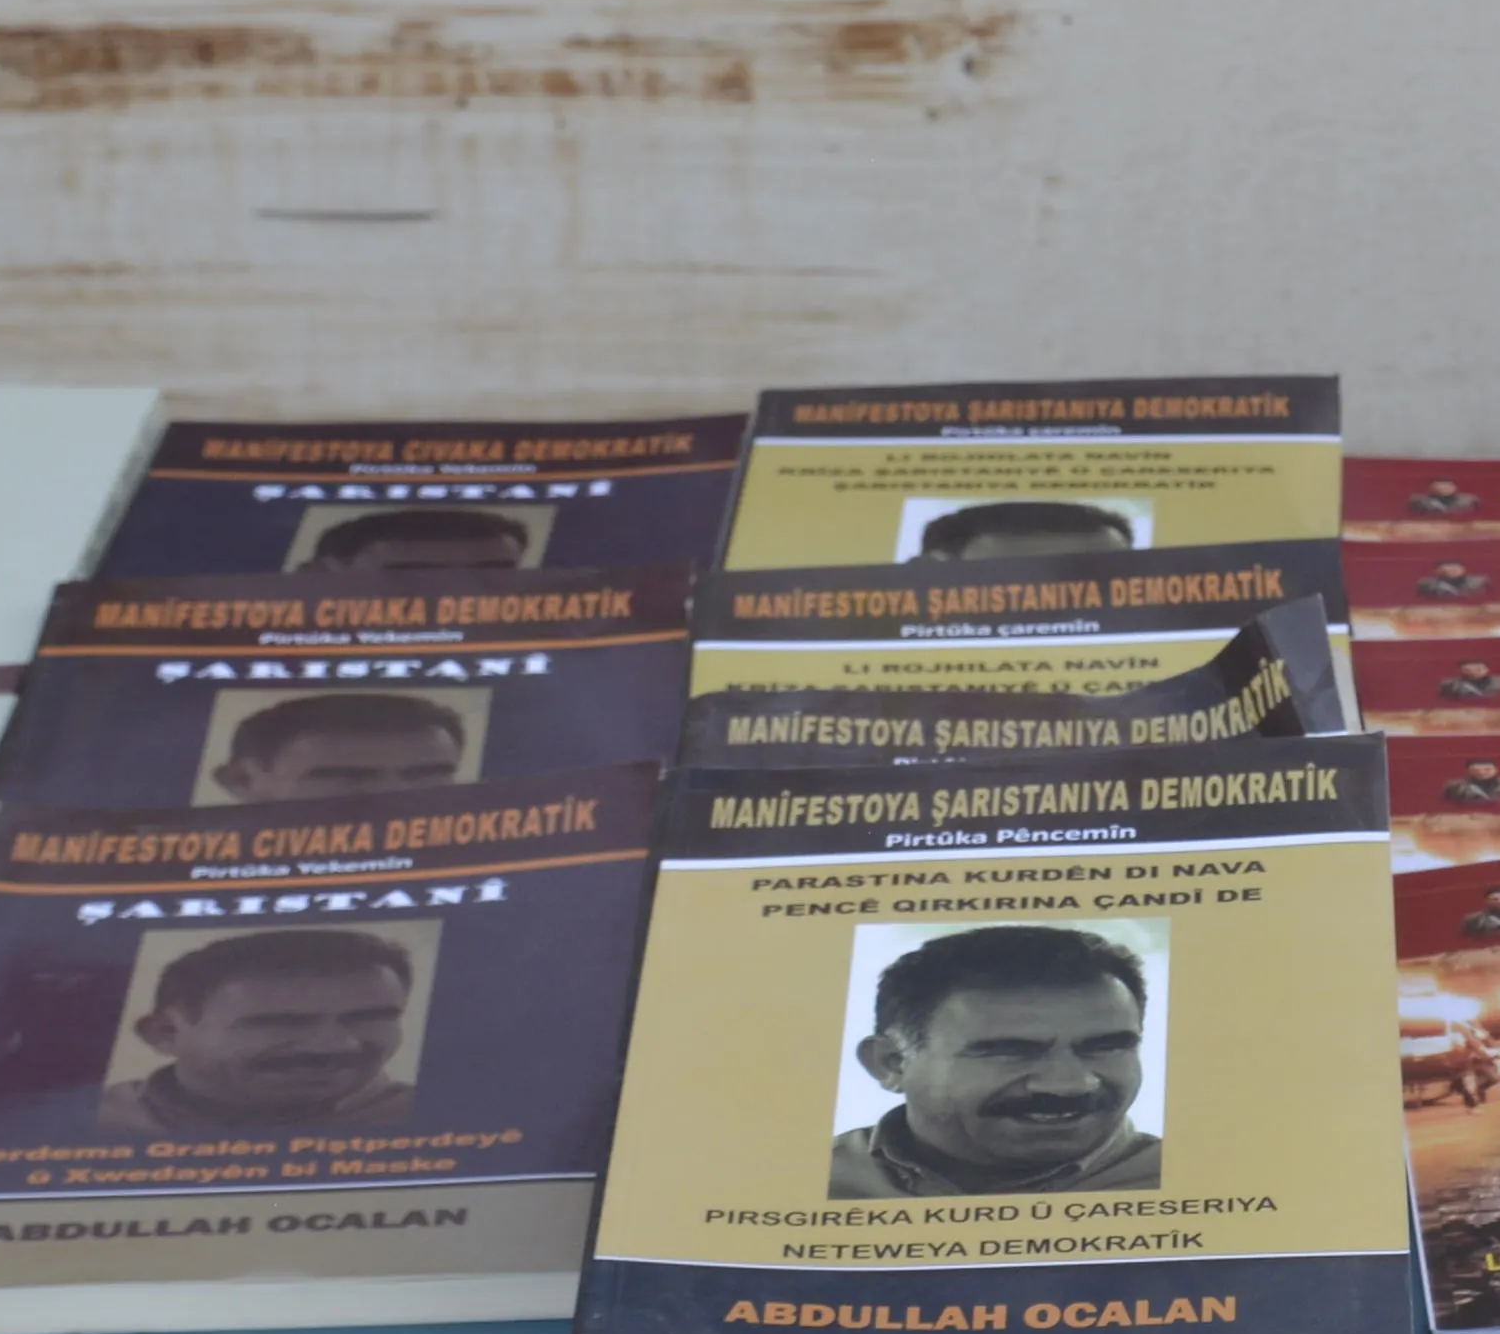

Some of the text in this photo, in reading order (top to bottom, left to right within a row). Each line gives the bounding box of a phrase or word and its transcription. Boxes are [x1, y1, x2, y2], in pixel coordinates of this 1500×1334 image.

[1132, 393, 1291, 419] DEMOKRATÎK
[404, 437, 505, 463] CIVAKA
[512, 432, 695, 460] DEMOKRATÎK
[94, 586, 634, 631] MANÎFESTOYA CIVAKA DEMOKRATÎK
[733, 562, 1284, 622] MANÎFESTOYA ŞARISTANIYA DEMOKRATÎK
[727, 709, 924, 748] MANÎFESTOYA
[934, 717, 1120, 755] ŞARISTANIYA
[1130, 656, 1291, 745] DEMOKRATÎK
[710, 762, 1338, 829] MANÎFESTOYA ŞARISTANIYA DEMOKRATÎK
[11, 794, 598, 865] MANÎFESTOYA CIVAKA DEMOKRATÎK
[885, 823, 1137, 848] Pirtûka Pêncemîn
[750, 859, 1267, 892] PARASTINA KURDÊN DI NAVA
[76, 877, 510, 926] ŞARISTANÎ
[760, 887, 1263, 919] PENCÊ QIRKIRINA ÇANDÎ DE
[63, 1161, 269, 1185] Xwedayên
[280, 1159, 319, 1178] bi
[330, 1155, 458, 1176] Maske
[267, 1206, 470, 1235] OCALAN
[704, 1195, 1279, 1228] PIRSGIRÊKA KURD Û ÇARESERIYA
[781, 1228, 1205, 1260] NETEWEYA DEMOKRATÎK
[723, 1295, 1238, 1332] ABDULLAH OCALAN
